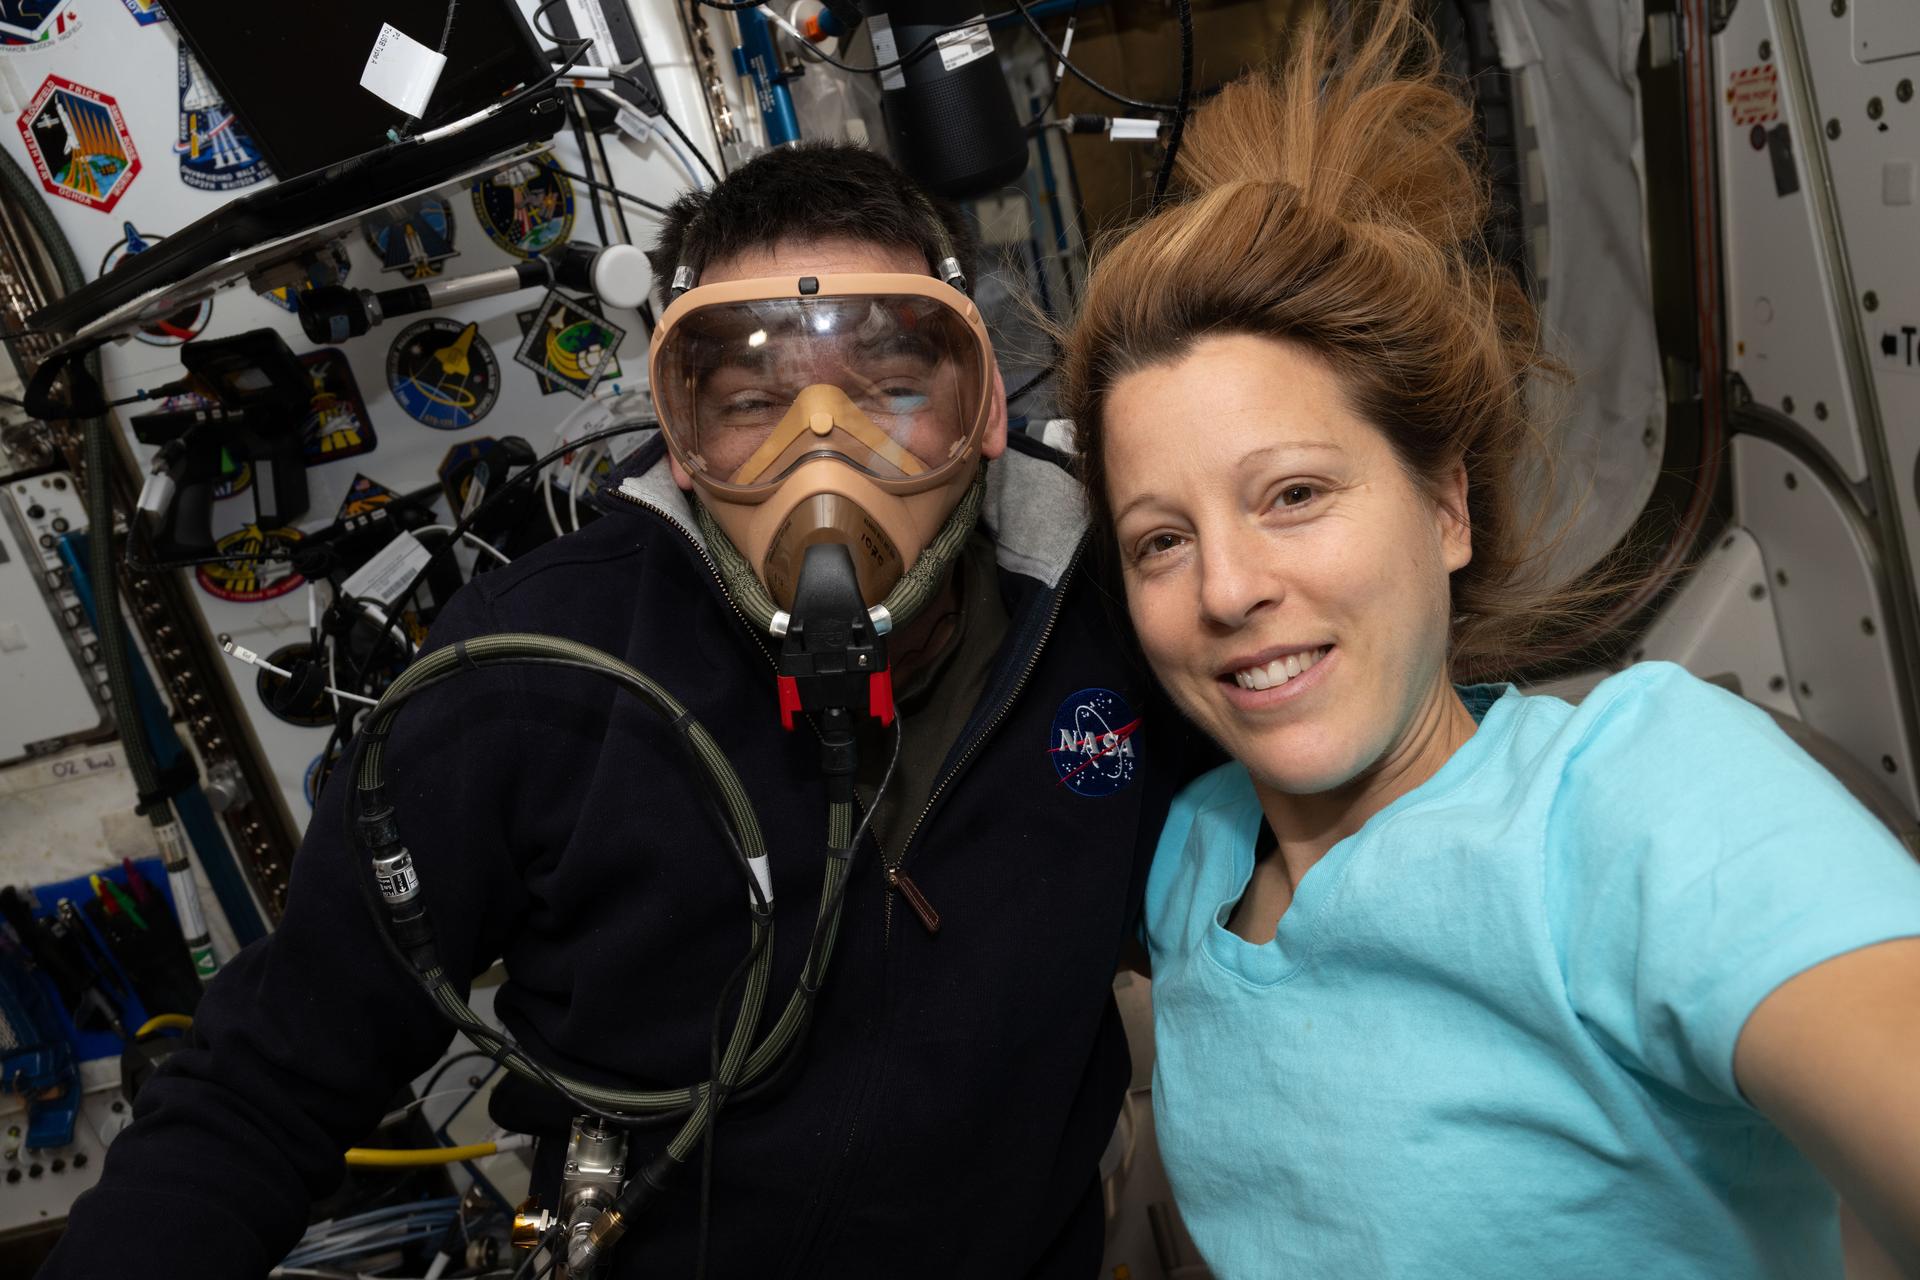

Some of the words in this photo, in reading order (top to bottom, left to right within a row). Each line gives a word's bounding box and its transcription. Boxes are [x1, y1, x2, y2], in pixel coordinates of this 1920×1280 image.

[379, 34, 389, 46] USB
[68, 83, 100, 101] FRICK
[212, 147, 252, 169] 111
[58, 187, 93, 205] OCHOA
[1901, 326, 1920, 366] T
[1058, 728, 1135, 758] NASA
